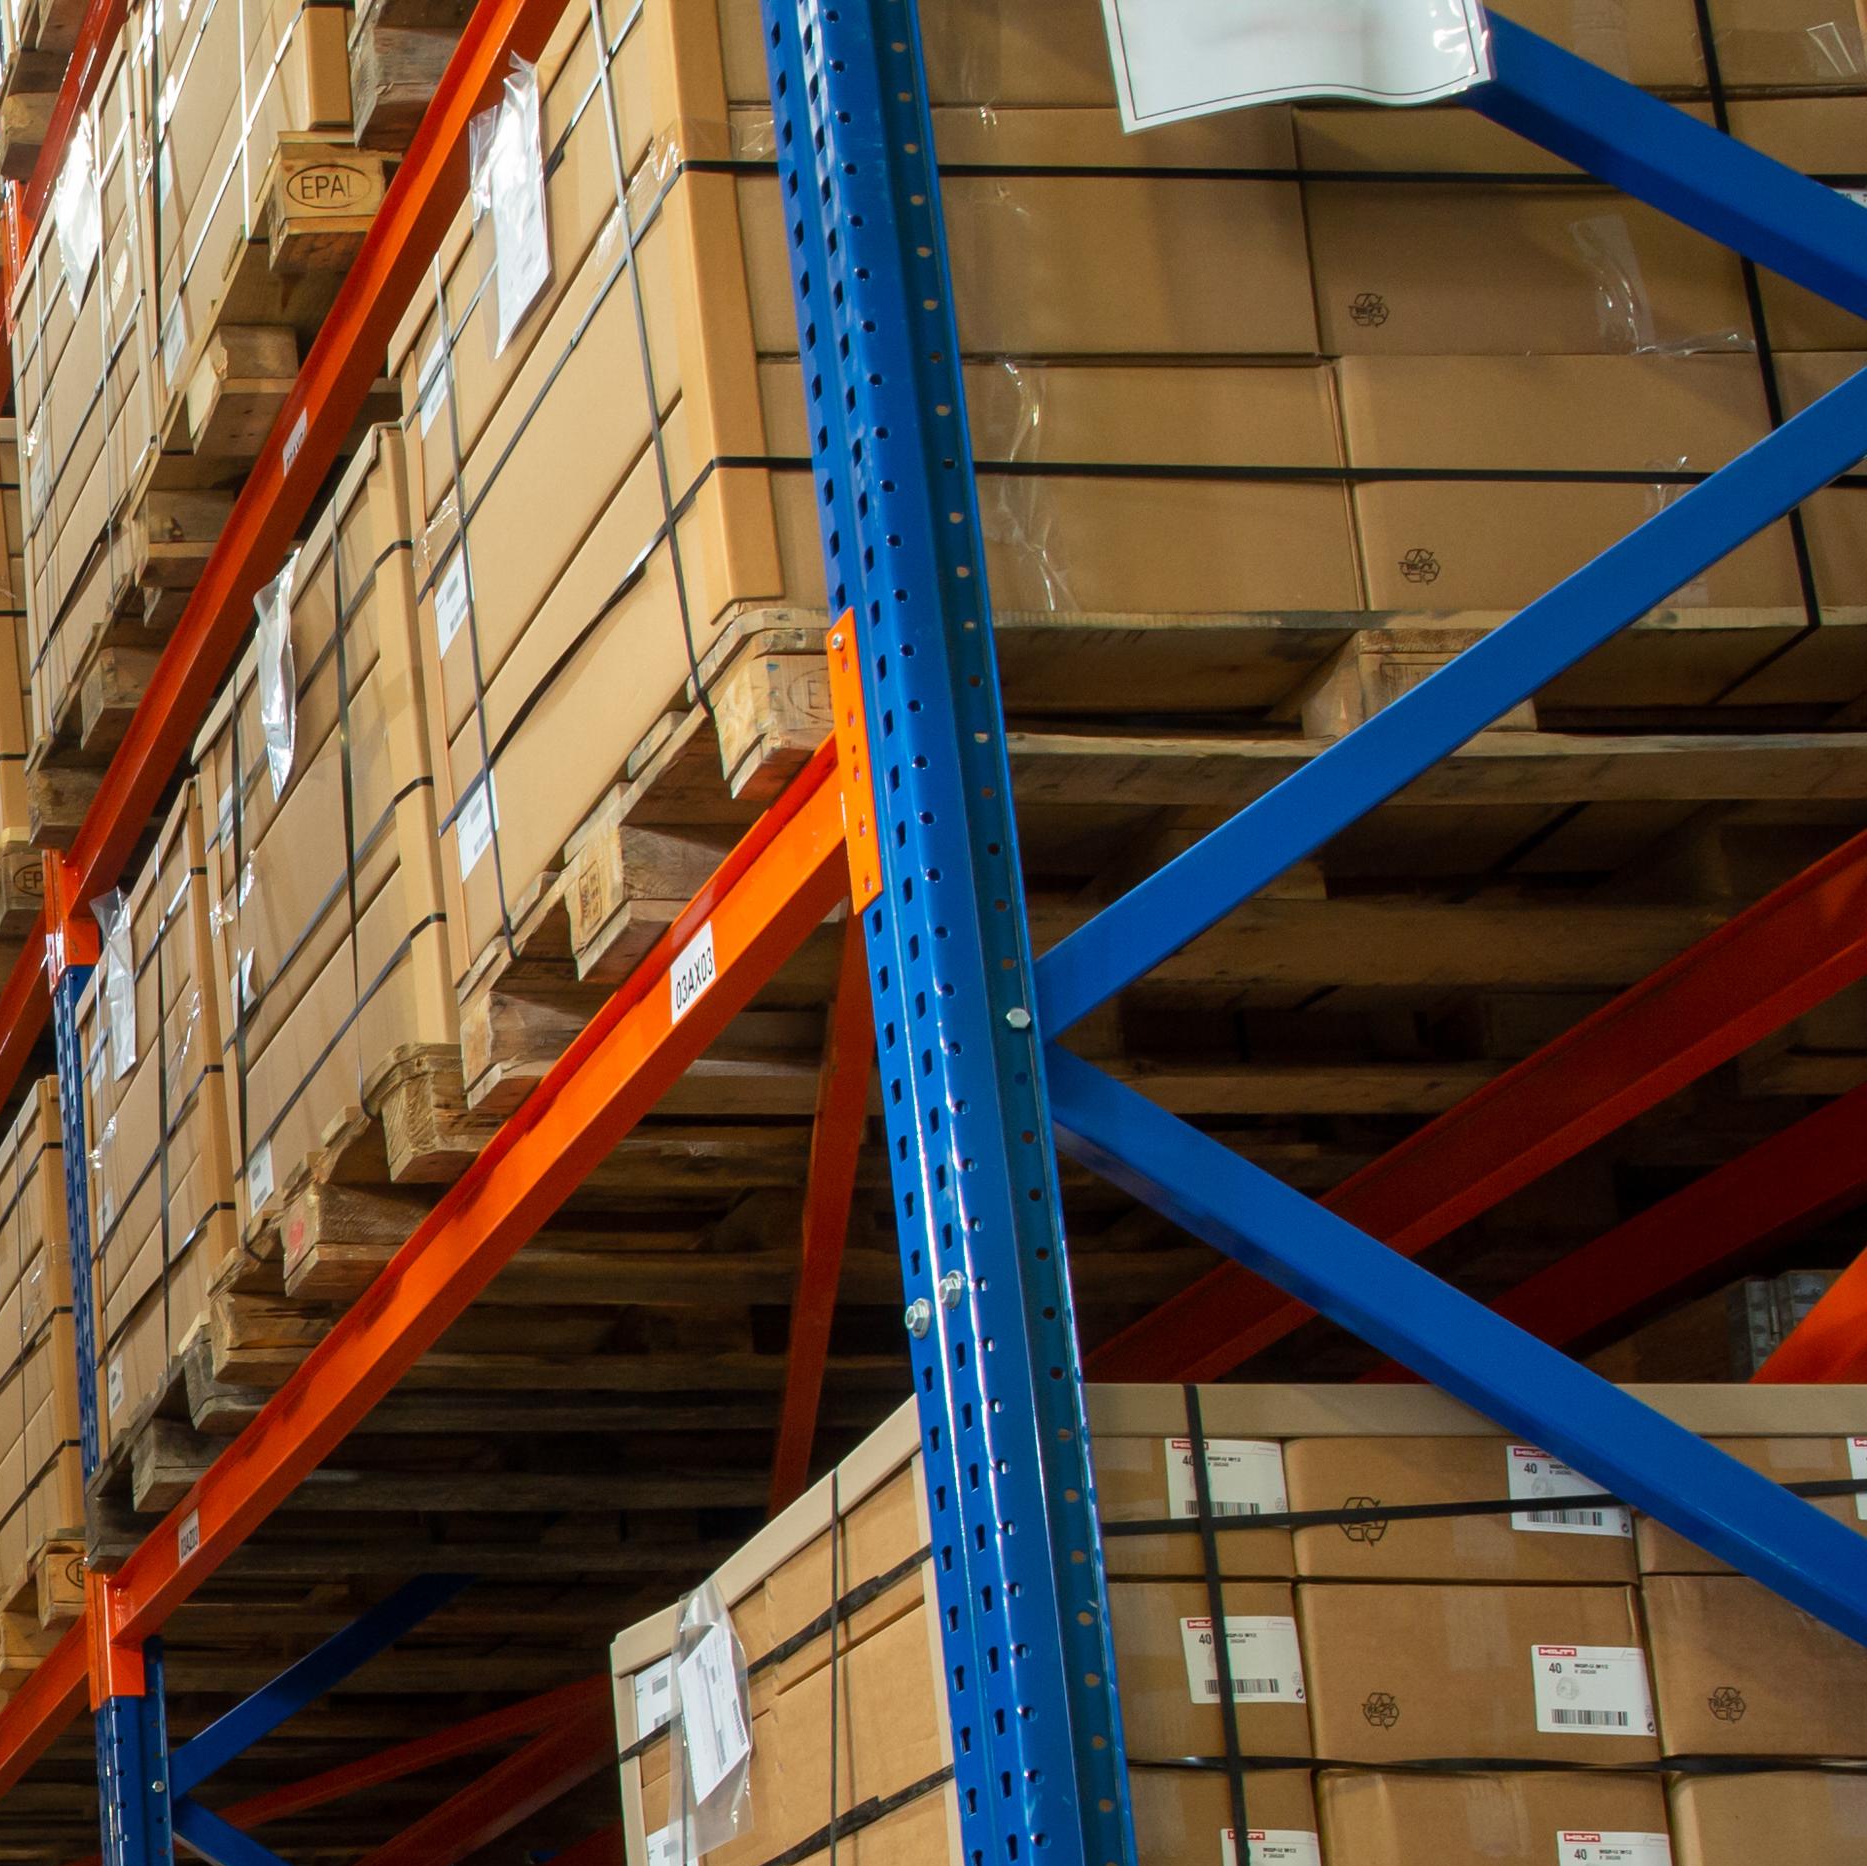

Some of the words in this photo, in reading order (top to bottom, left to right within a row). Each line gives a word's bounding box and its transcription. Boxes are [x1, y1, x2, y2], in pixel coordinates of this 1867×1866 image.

[23, 870, 43, 889] EP
[674, 945, 714, 1011] 03AX03
[1523, 1462, 1538, 1474] 40
[1198, 1633, 1212, 1645] 40
[1548, 1662, 1562, 1674] 40
[1573, 1848, 1587, 1860] 40
